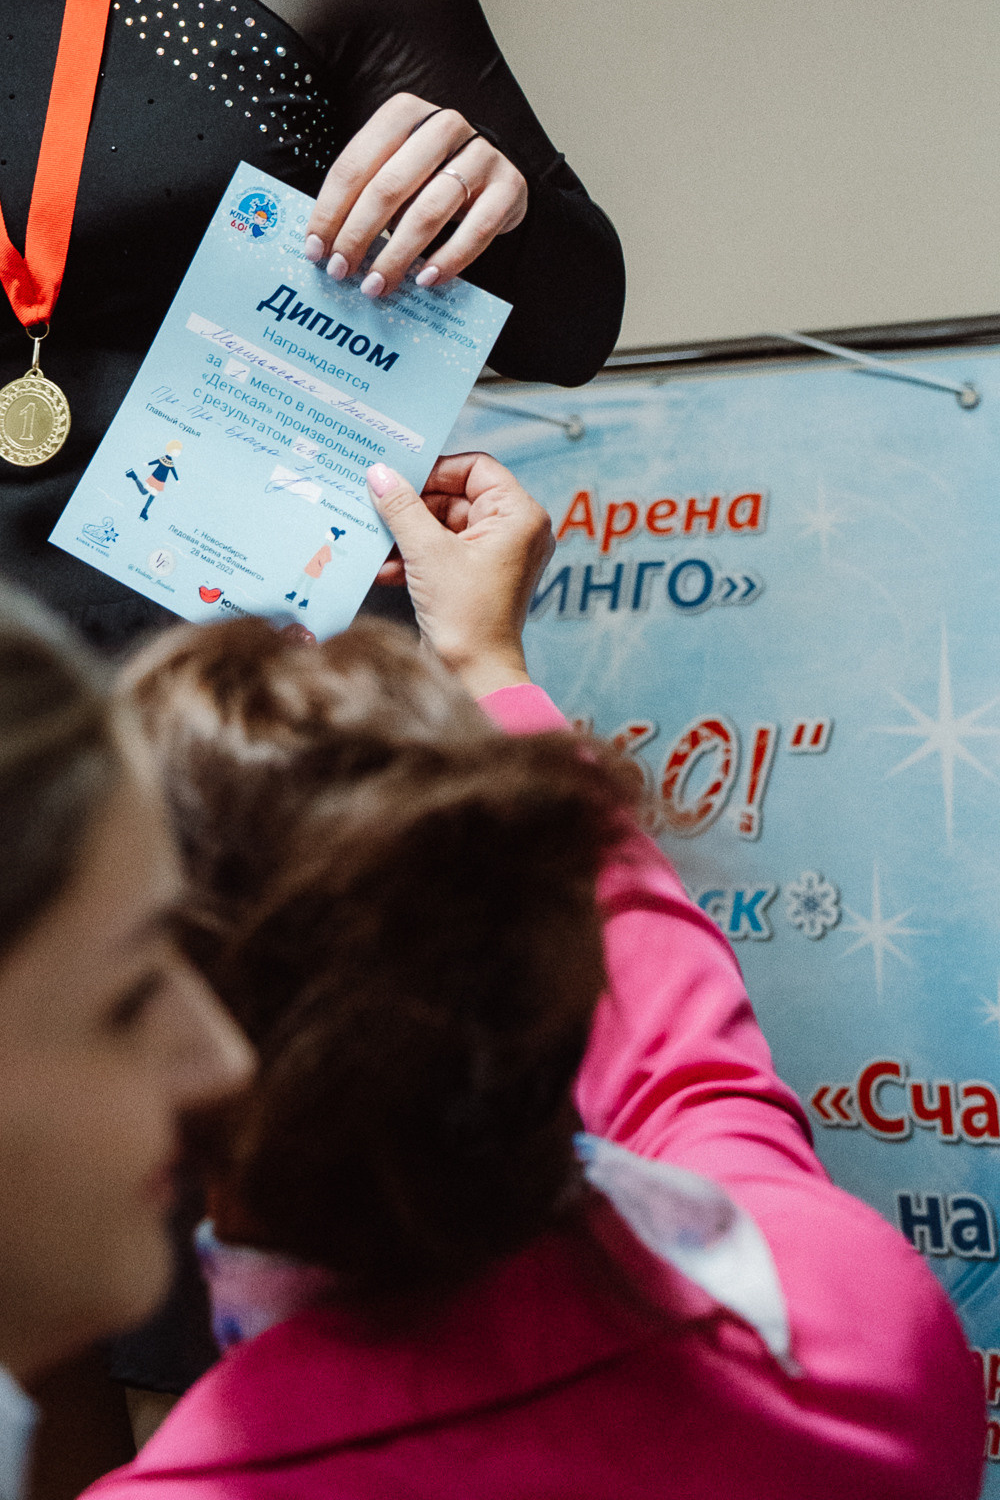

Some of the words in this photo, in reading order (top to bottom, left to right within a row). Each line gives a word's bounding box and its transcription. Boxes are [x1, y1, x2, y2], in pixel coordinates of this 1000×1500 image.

[229, 208, 251, 225] КЛУБ
[255, 283, 399, 374] Диплом
[422, 300, 466, 328] катанию
[261, 325, 372, 393] Награждается
[18, 402, 36, 441] 1
[144, 401, 179, 425] Главный
[177, 421, 201, 439] судья
[199, 368, 275, 417] «Детская»
[274, 409, 375, 470] произвольная
[205, 352, 223, 368] за
[229, 364, 246, 381] 1
[249, 375, 296, 407] место
[295, 400, 306, 412] в
[304, 405, 387, 458] программе
[191, 386, 202, 398] с
[201, 392, 293, 449] результатом
[315, 450, 369, 488] баллов
[319, 497, 365, 527] Алексеенко
[556, 491, 761, 554] Арена
[167, 523, 200, 546] Ледовая
[199, 542, 221, 558] арена
[221, 553, 266, 582] «Фламинго»
[189, 546, 200, 557] 28
[200, 553, 215, 565] мая
[214, 560, 235, 576] 2023
[199, 531, 248, 562] Новосибирск
[899, 1193, 992, 1253] на
